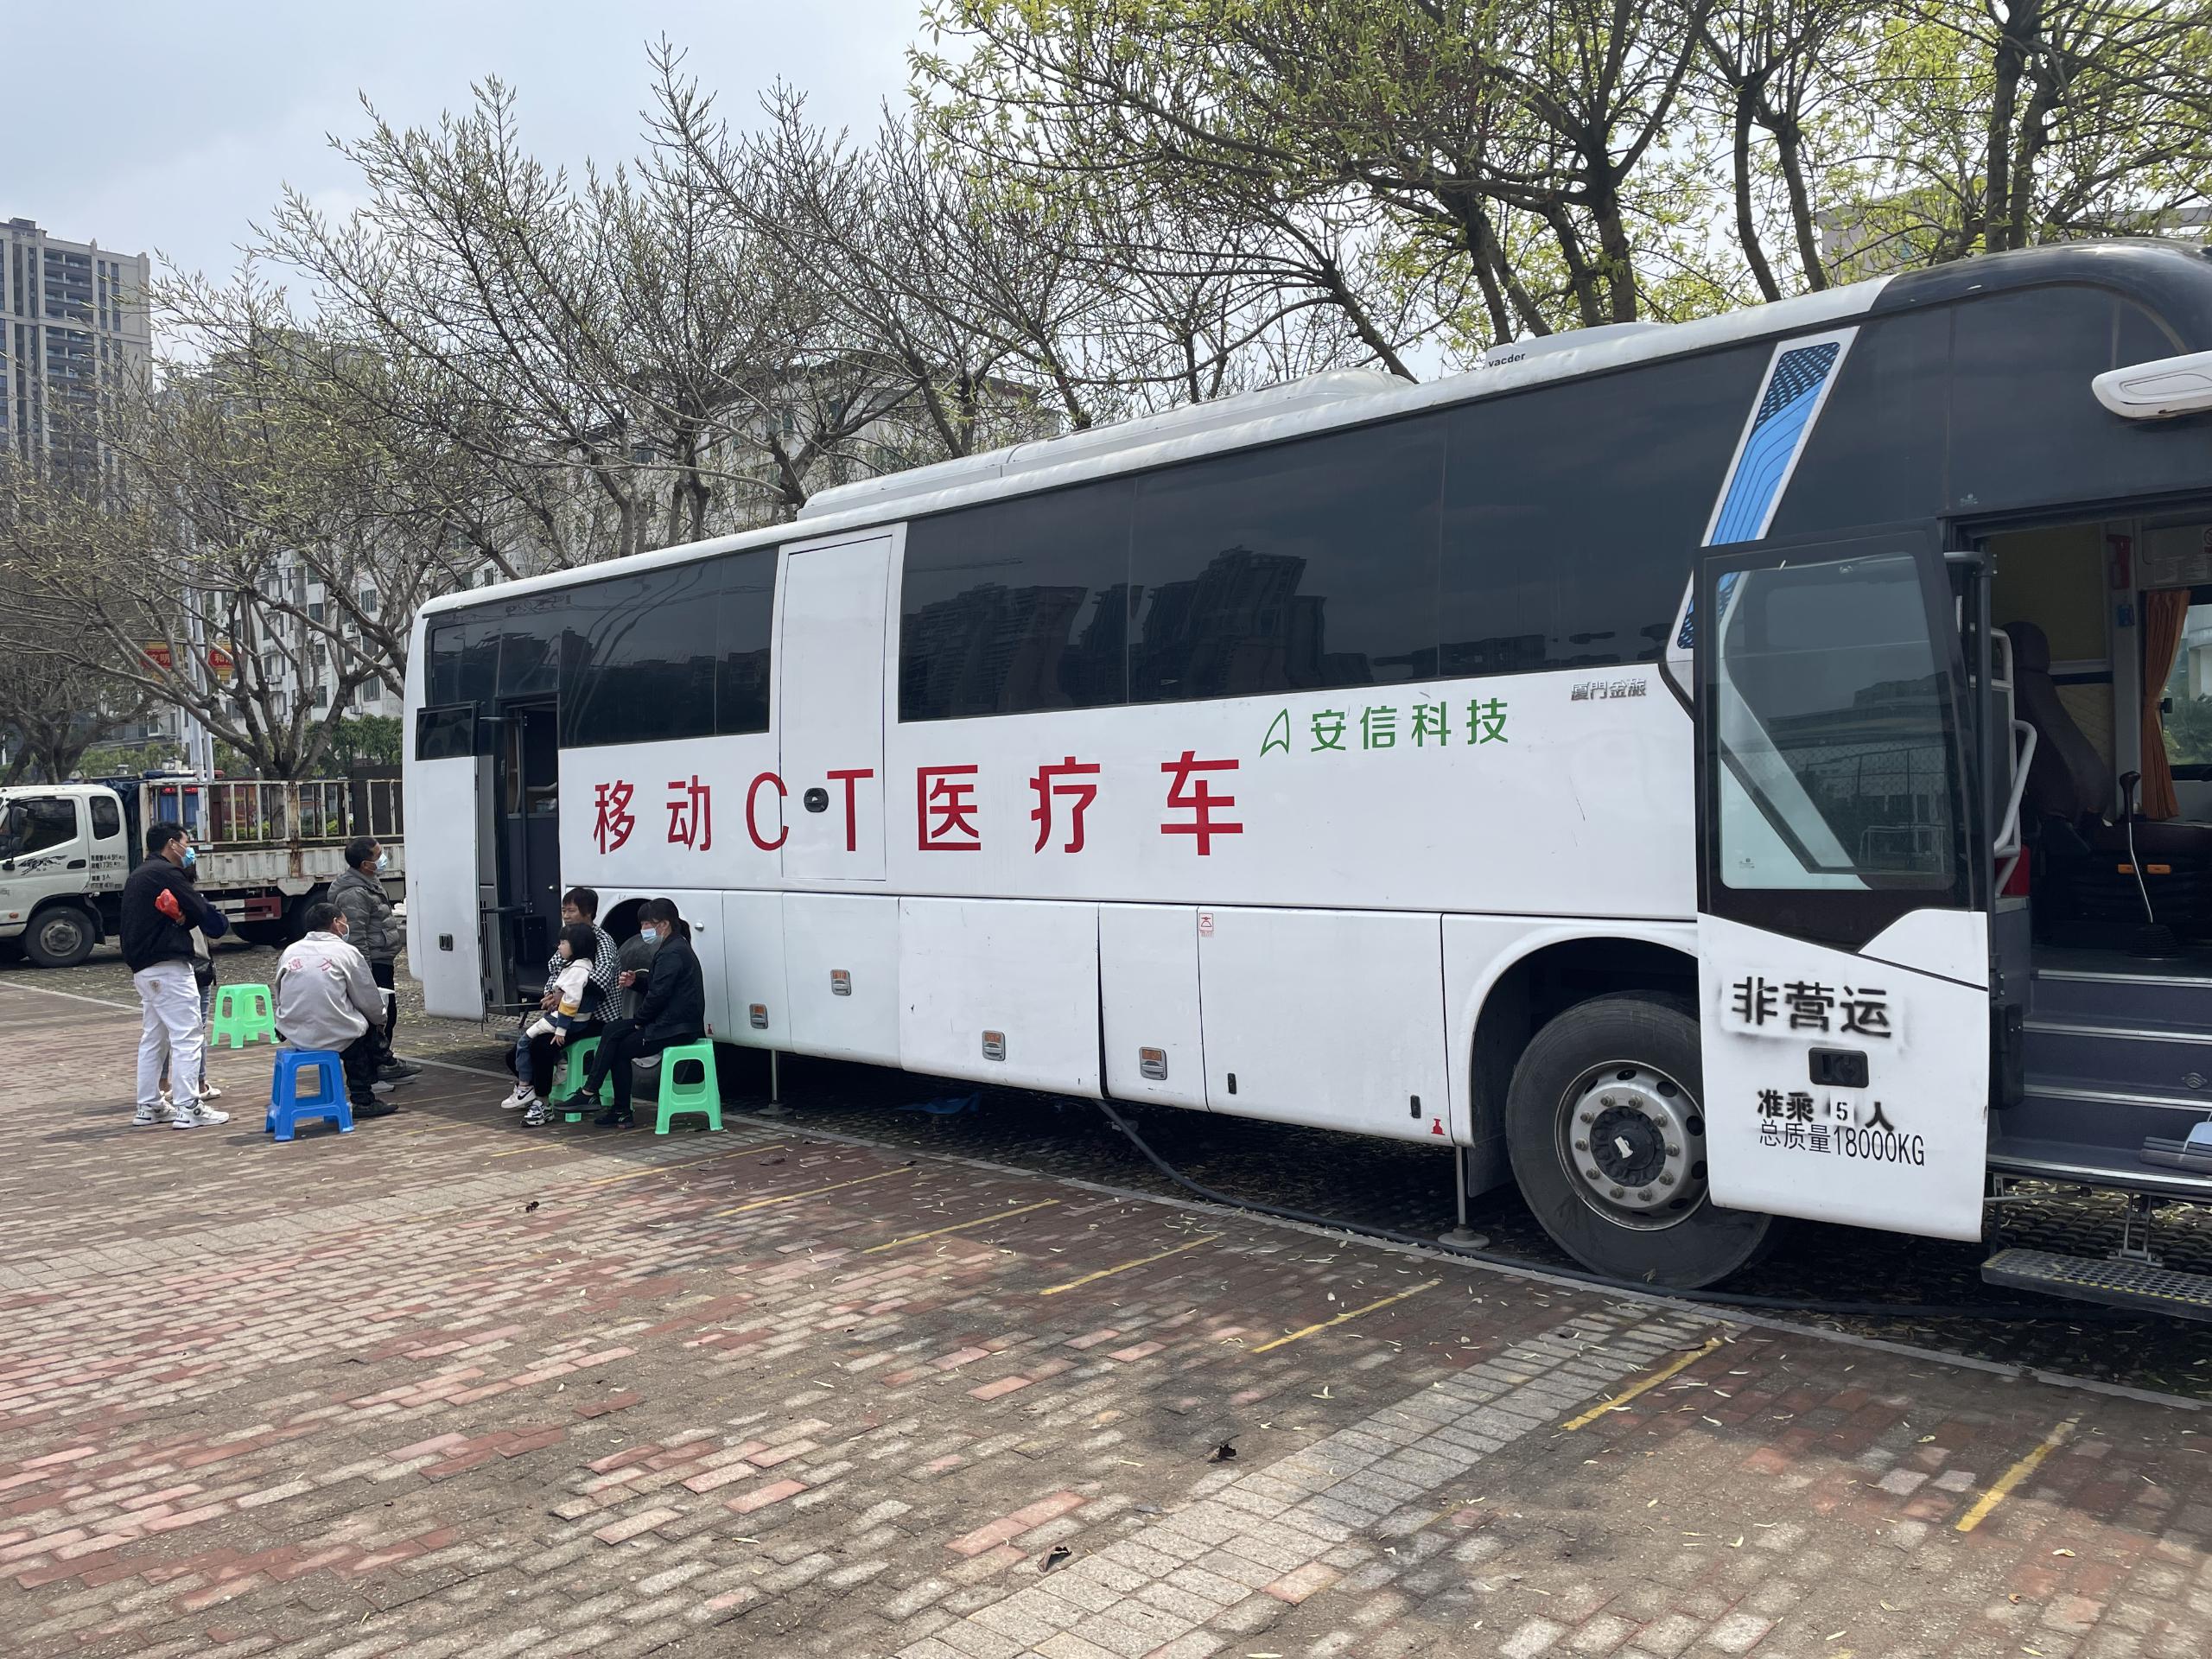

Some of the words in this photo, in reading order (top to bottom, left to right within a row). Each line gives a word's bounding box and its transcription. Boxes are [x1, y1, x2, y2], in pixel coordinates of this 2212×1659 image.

[1488, 353, 1526, 367] vacder
[1310, 697, 1510, 753] 安信科技
[1732, 976, 1891, 1039] 非营运
[1759, 1119, 1924, 1166] 总质量18000KG
